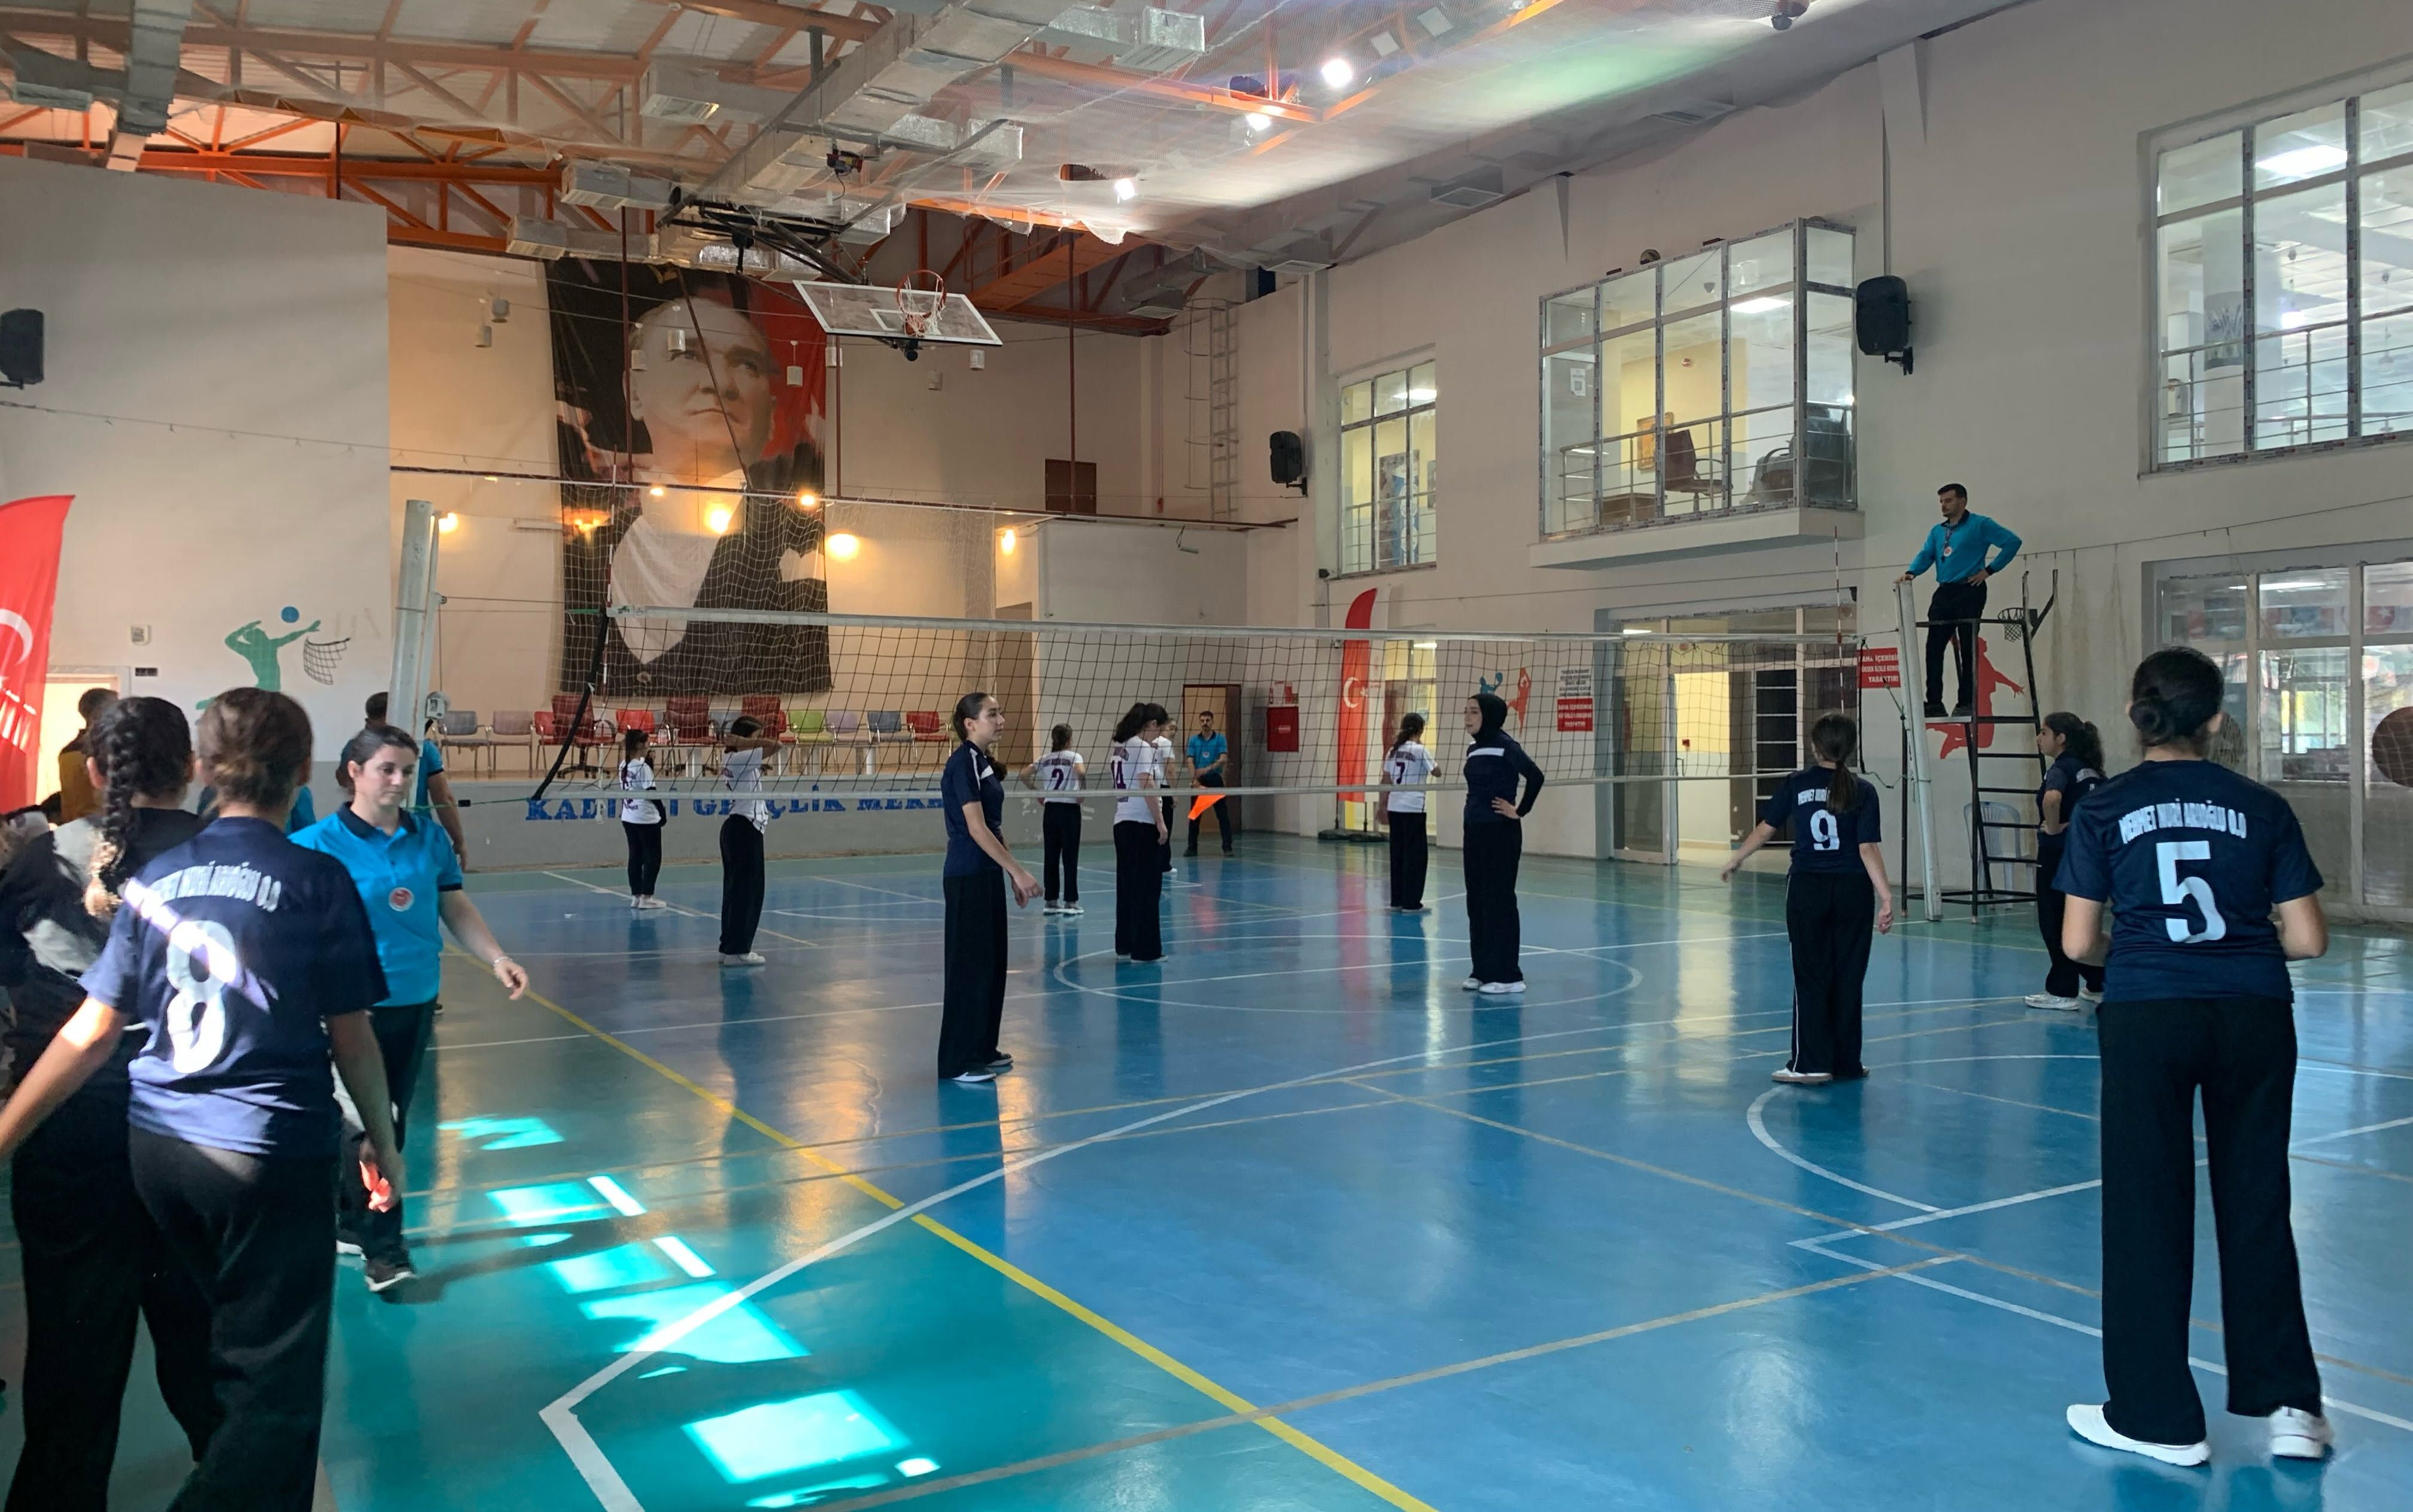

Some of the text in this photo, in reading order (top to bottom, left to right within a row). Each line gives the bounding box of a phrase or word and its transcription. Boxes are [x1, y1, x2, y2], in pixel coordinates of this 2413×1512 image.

[1396, 762, 1405, 784] 7
[1810, 810, 1840, 850] 9
[2156, 841, 2226, 943] 5
[166, 920, 237, 1073] 8
